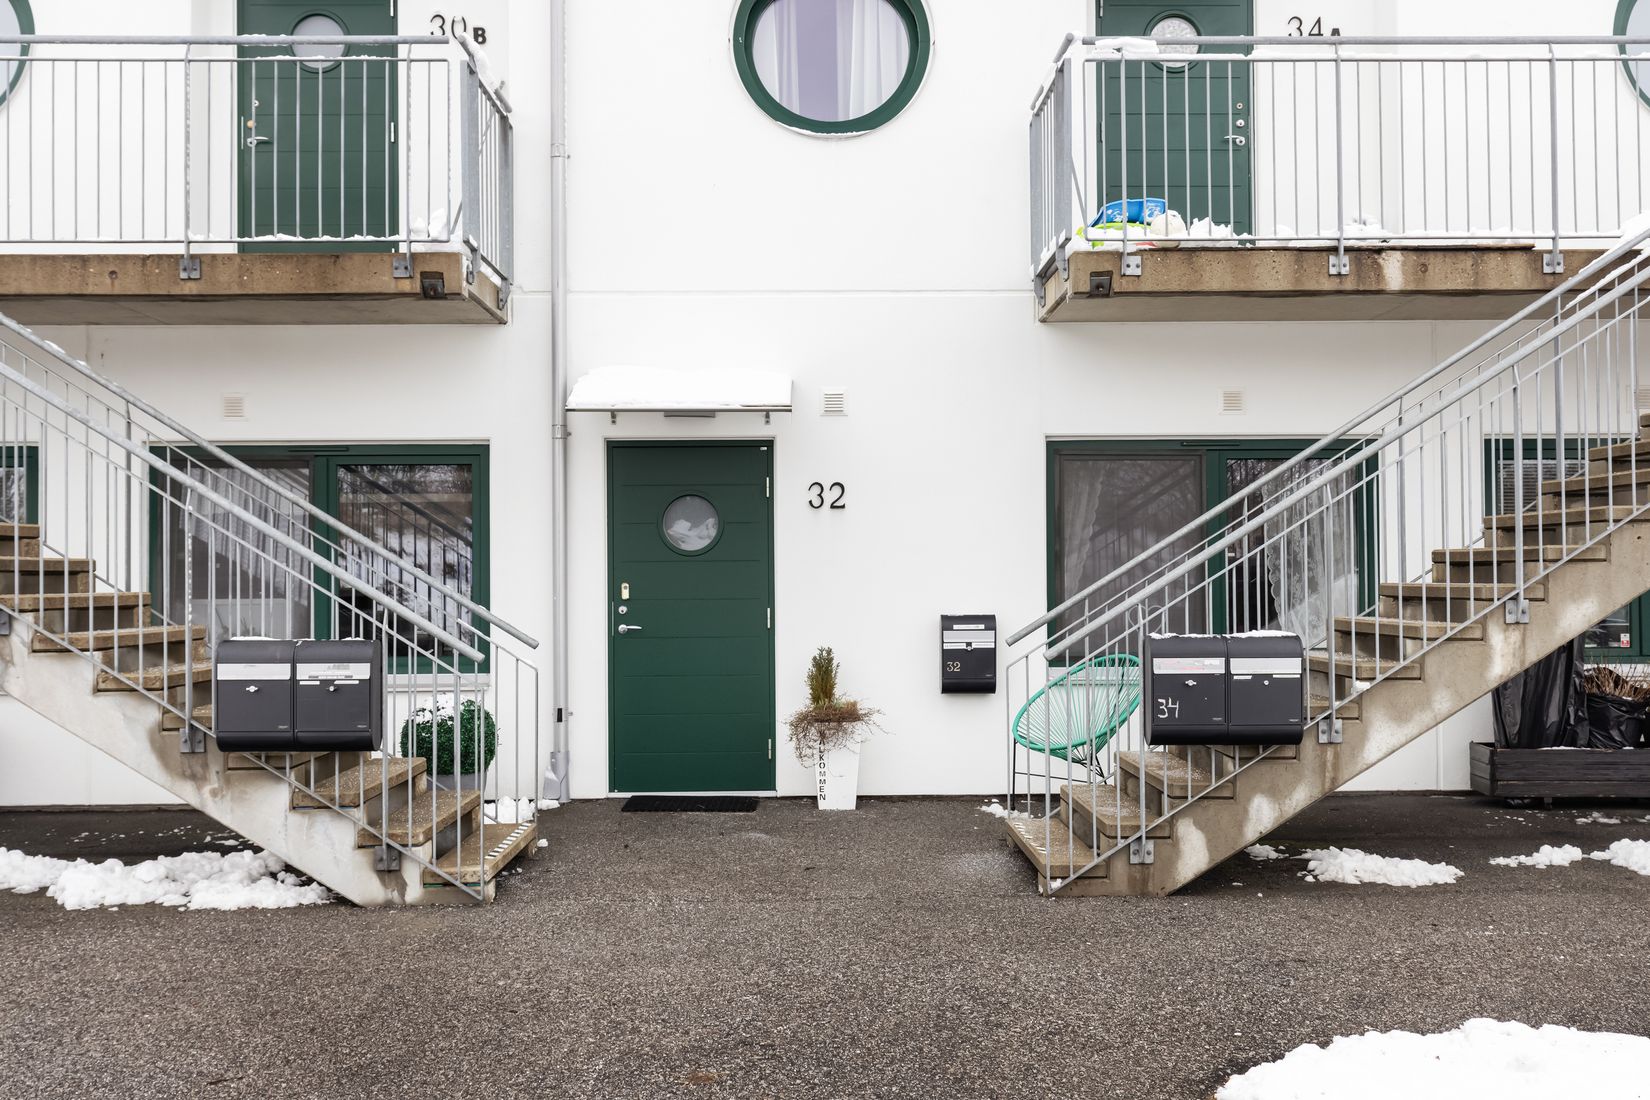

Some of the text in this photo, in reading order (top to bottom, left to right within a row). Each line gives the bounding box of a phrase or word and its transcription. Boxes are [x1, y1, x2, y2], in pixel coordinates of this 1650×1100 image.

[808, 481, 846, 509] 32
[946, 661, 961, 672] 32
[1157, 696, 1180, 719] 34
